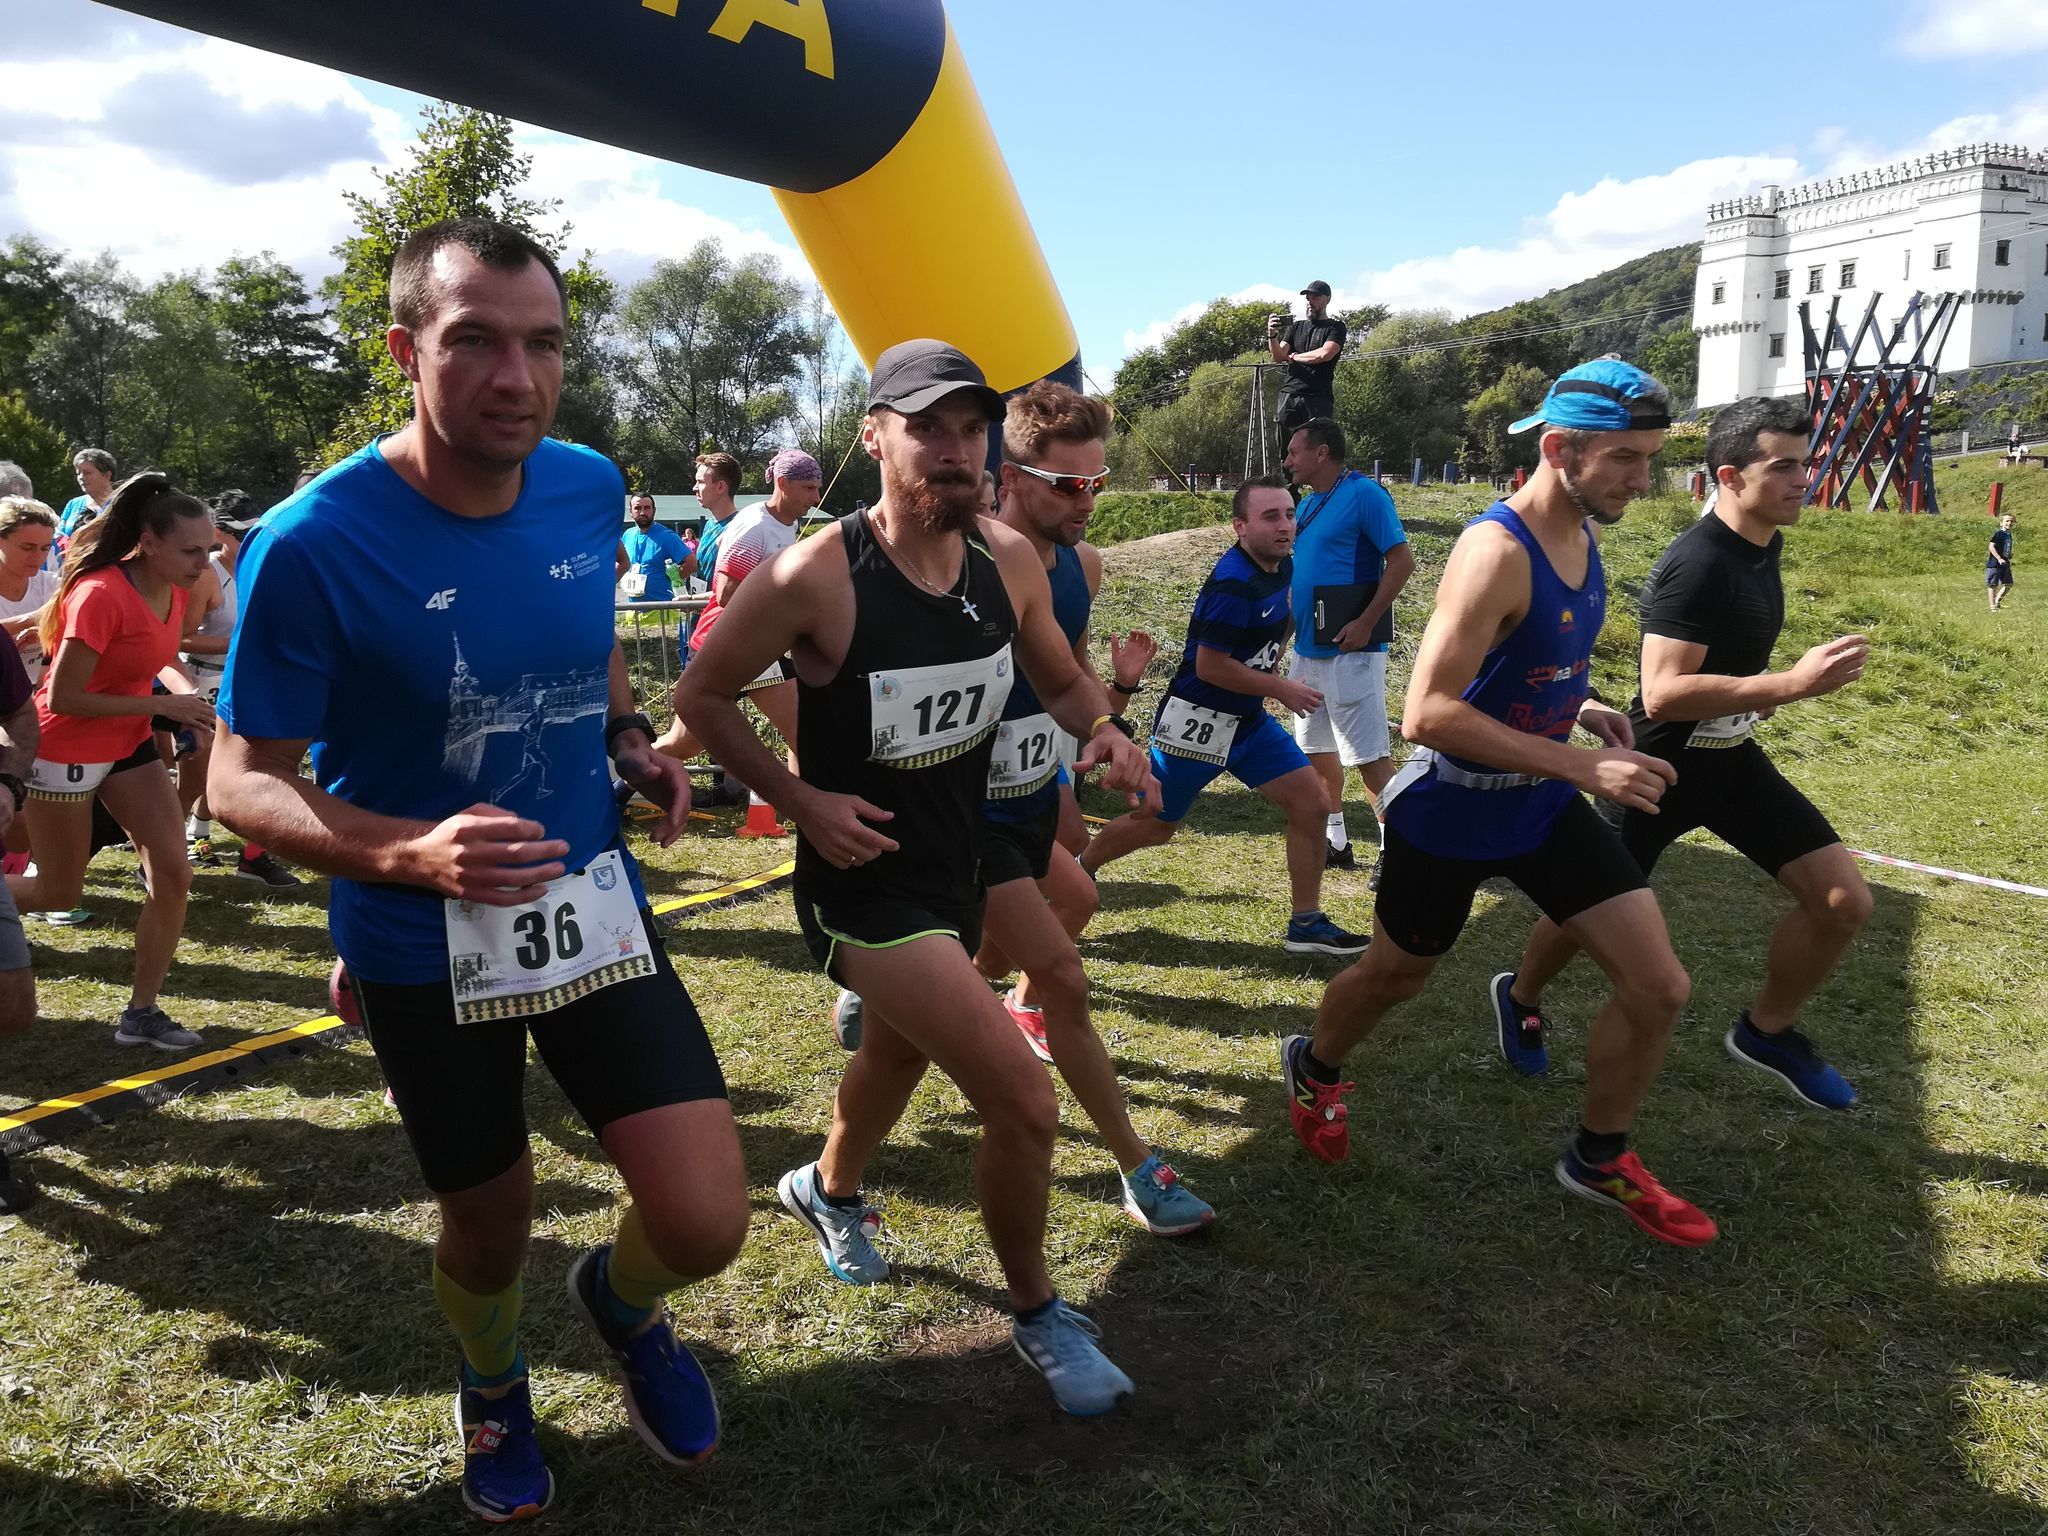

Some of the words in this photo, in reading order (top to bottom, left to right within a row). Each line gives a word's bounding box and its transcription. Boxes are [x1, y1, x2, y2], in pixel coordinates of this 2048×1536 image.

[642, 0, 835, 81] A
[425, 588, 457, 611] 4F
[913, 683, 986, 737] 127
[1180, 718, 1215, 745] 28
[66, 763, 84, 783] 6
[513, 901, 584, 970] 36
[482, 1433, 501, 1448] 036
